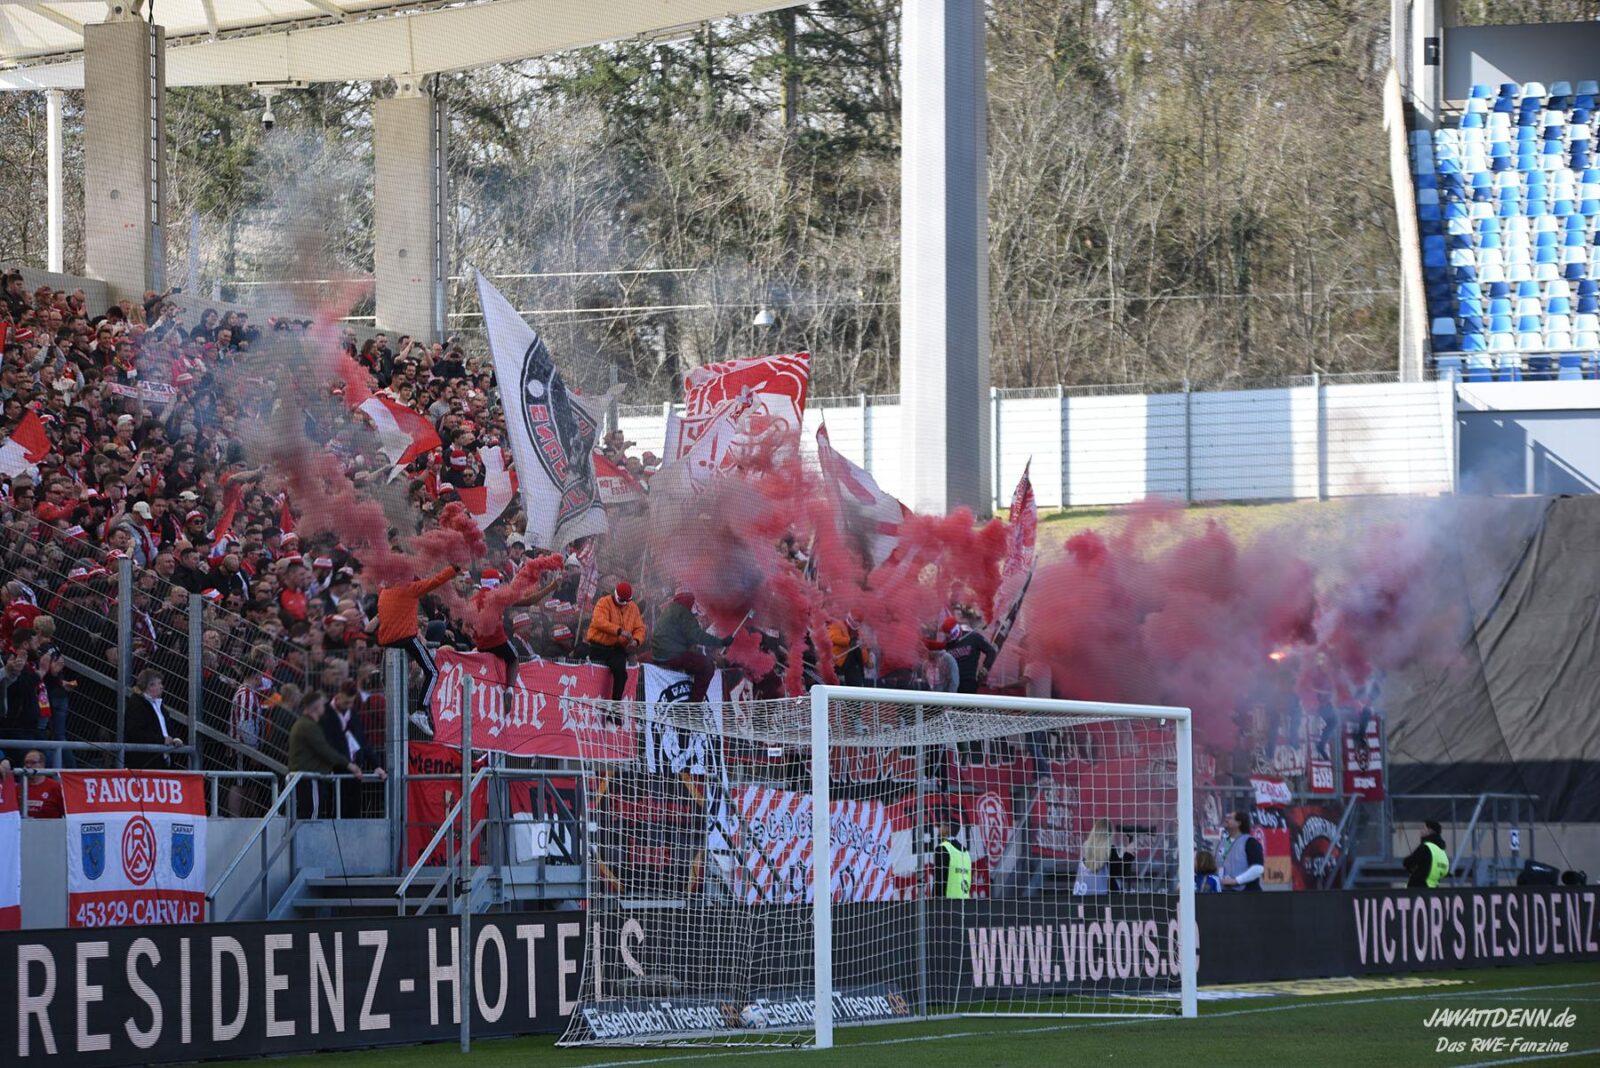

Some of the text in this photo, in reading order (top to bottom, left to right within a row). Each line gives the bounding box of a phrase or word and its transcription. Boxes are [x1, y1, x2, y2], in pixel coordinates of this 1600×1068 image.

[558, 674, 641, 733] Essn
[84, 777, 183, 804] FANCLUB
[77, 899, 199, 927] 45329-CARNAP
[1353, 894, 1467, 965] VICTOR'S
[968, 902, 1201, 988] www.victors.d
